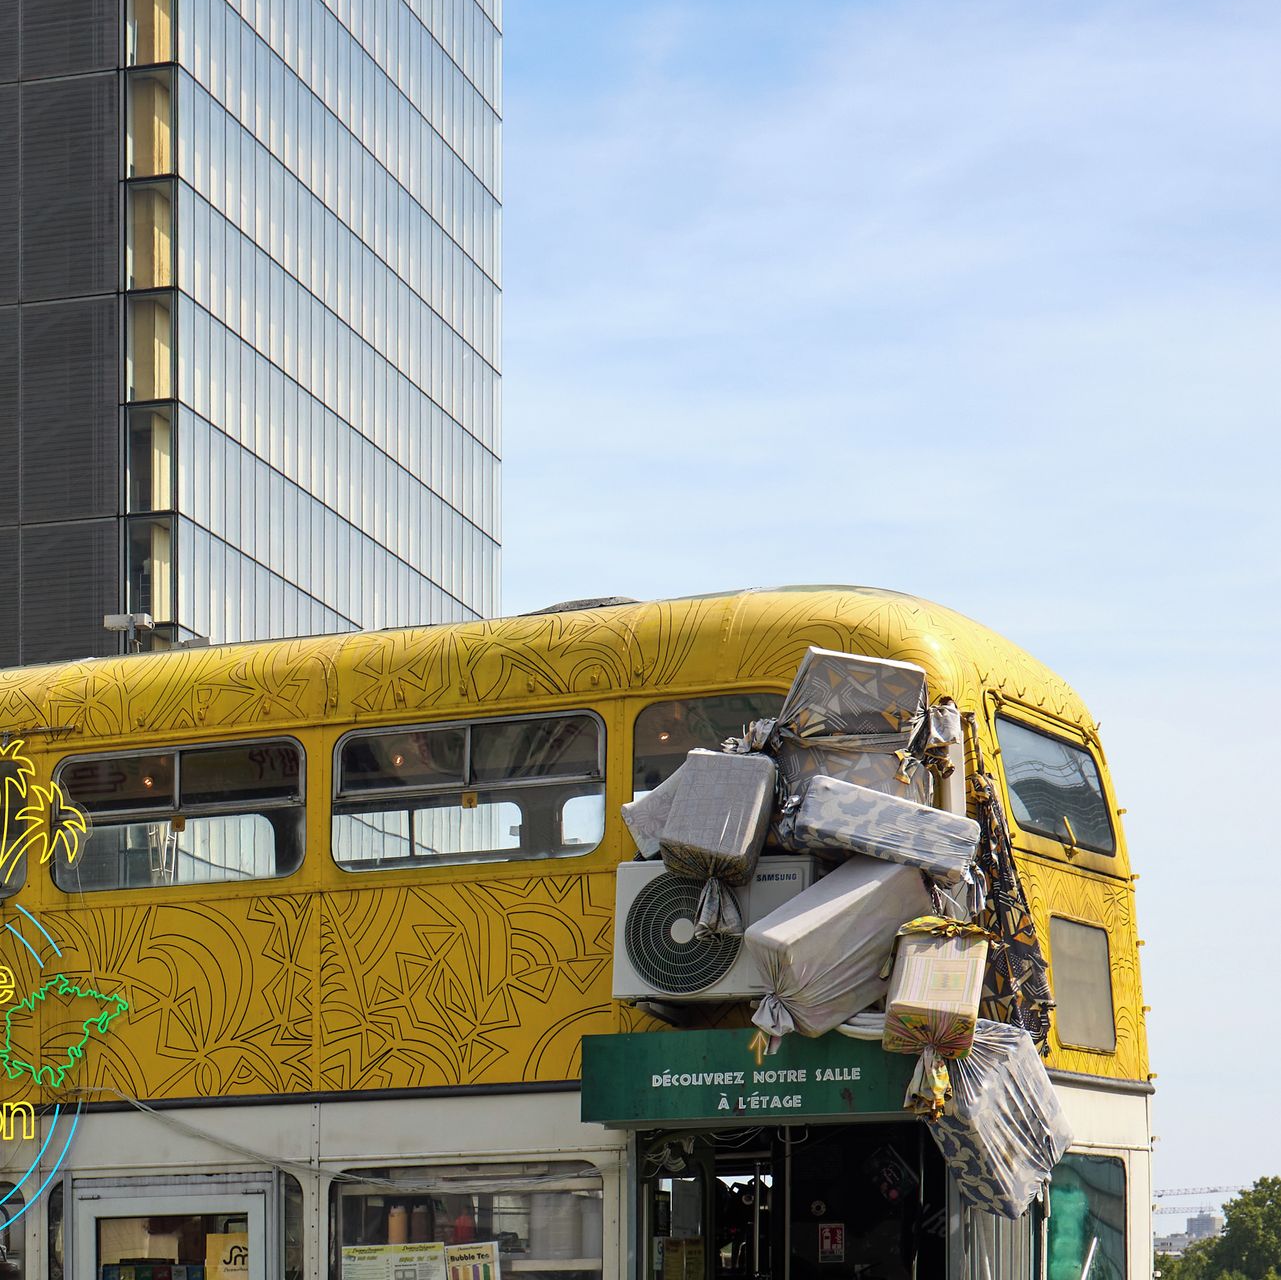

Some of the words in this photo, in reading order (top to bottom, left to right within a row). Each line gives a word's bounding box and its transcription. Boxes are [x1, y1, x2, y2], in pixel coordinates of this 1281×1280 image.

[756, 873, 797, 882] SAMSUNG
[652, 1069, 745, 1087] DÉCOUVREZ
[753, 1070, 807, 1084] NOTRE
[815, 1067, 861, 1081] SALLE
[718, 1093, 730, 1109] À
[738, 1092, 802, 1109] L'ÉTAGE
[450, 1253, 475, 1262] Bubble
